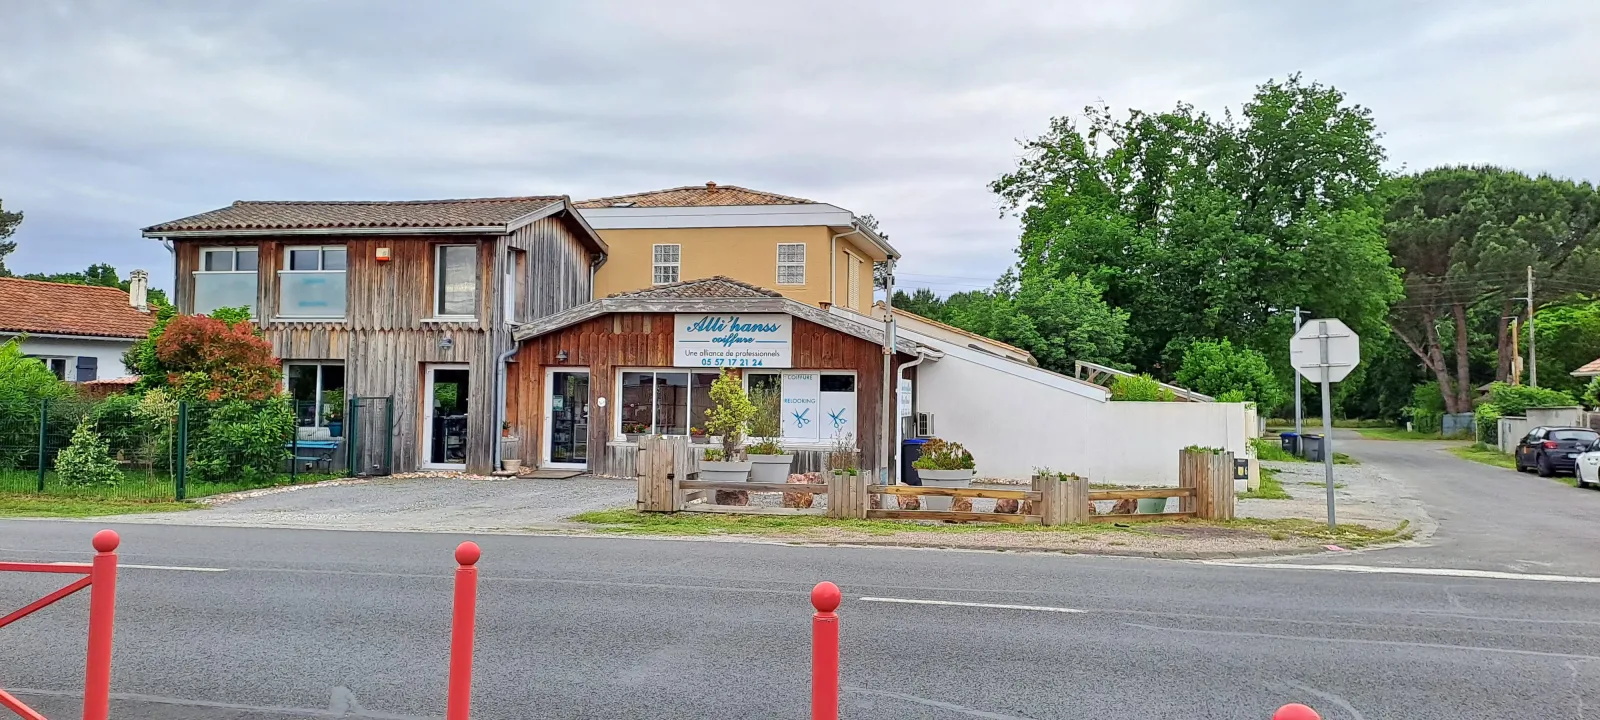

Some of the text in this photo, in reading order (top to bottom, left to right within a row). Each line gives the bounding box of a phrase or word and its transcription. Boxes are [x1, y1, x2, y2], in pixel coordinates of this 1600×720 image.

[712, 333, 755, 347] coiffure
[699, 349, 724, 357] alliance
[726, 349, 734, 357] de
[735, 349, 780, 359] professionnels
[701, 358, 763, 367] 05 57 17 21 24
